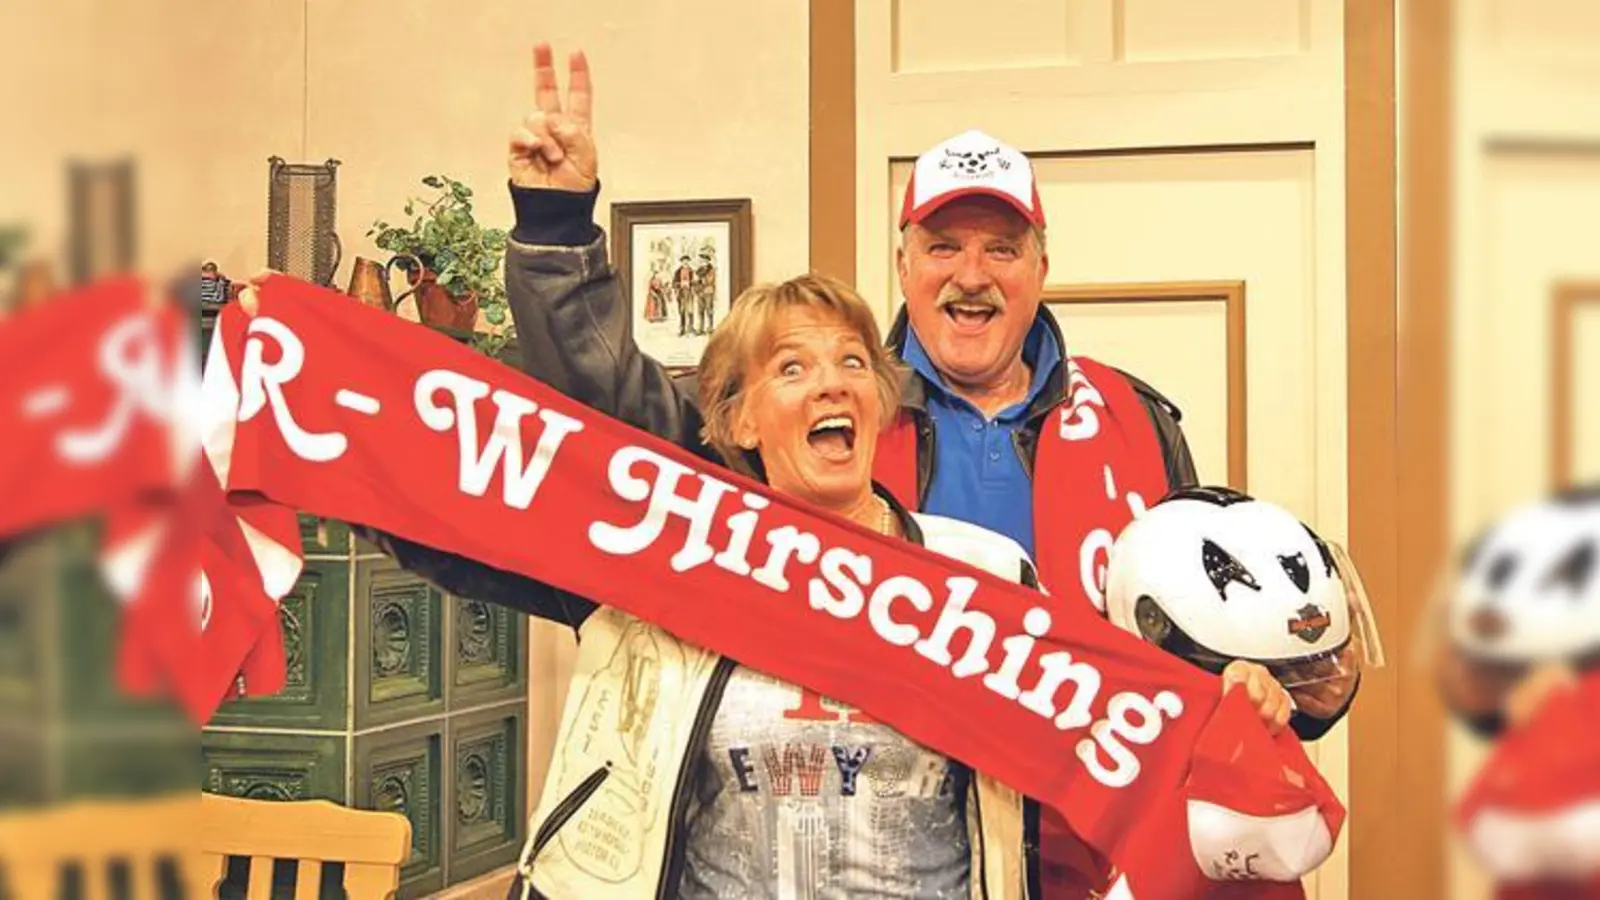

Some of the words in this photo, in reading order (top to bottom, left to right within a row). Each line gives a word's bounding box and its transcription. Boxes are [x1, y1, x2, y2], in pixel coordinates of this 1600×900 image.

[238, 316, 348, 462] R
[413, 368, 585, 511] W
[588, 445, 1184, 788] Hirsching
